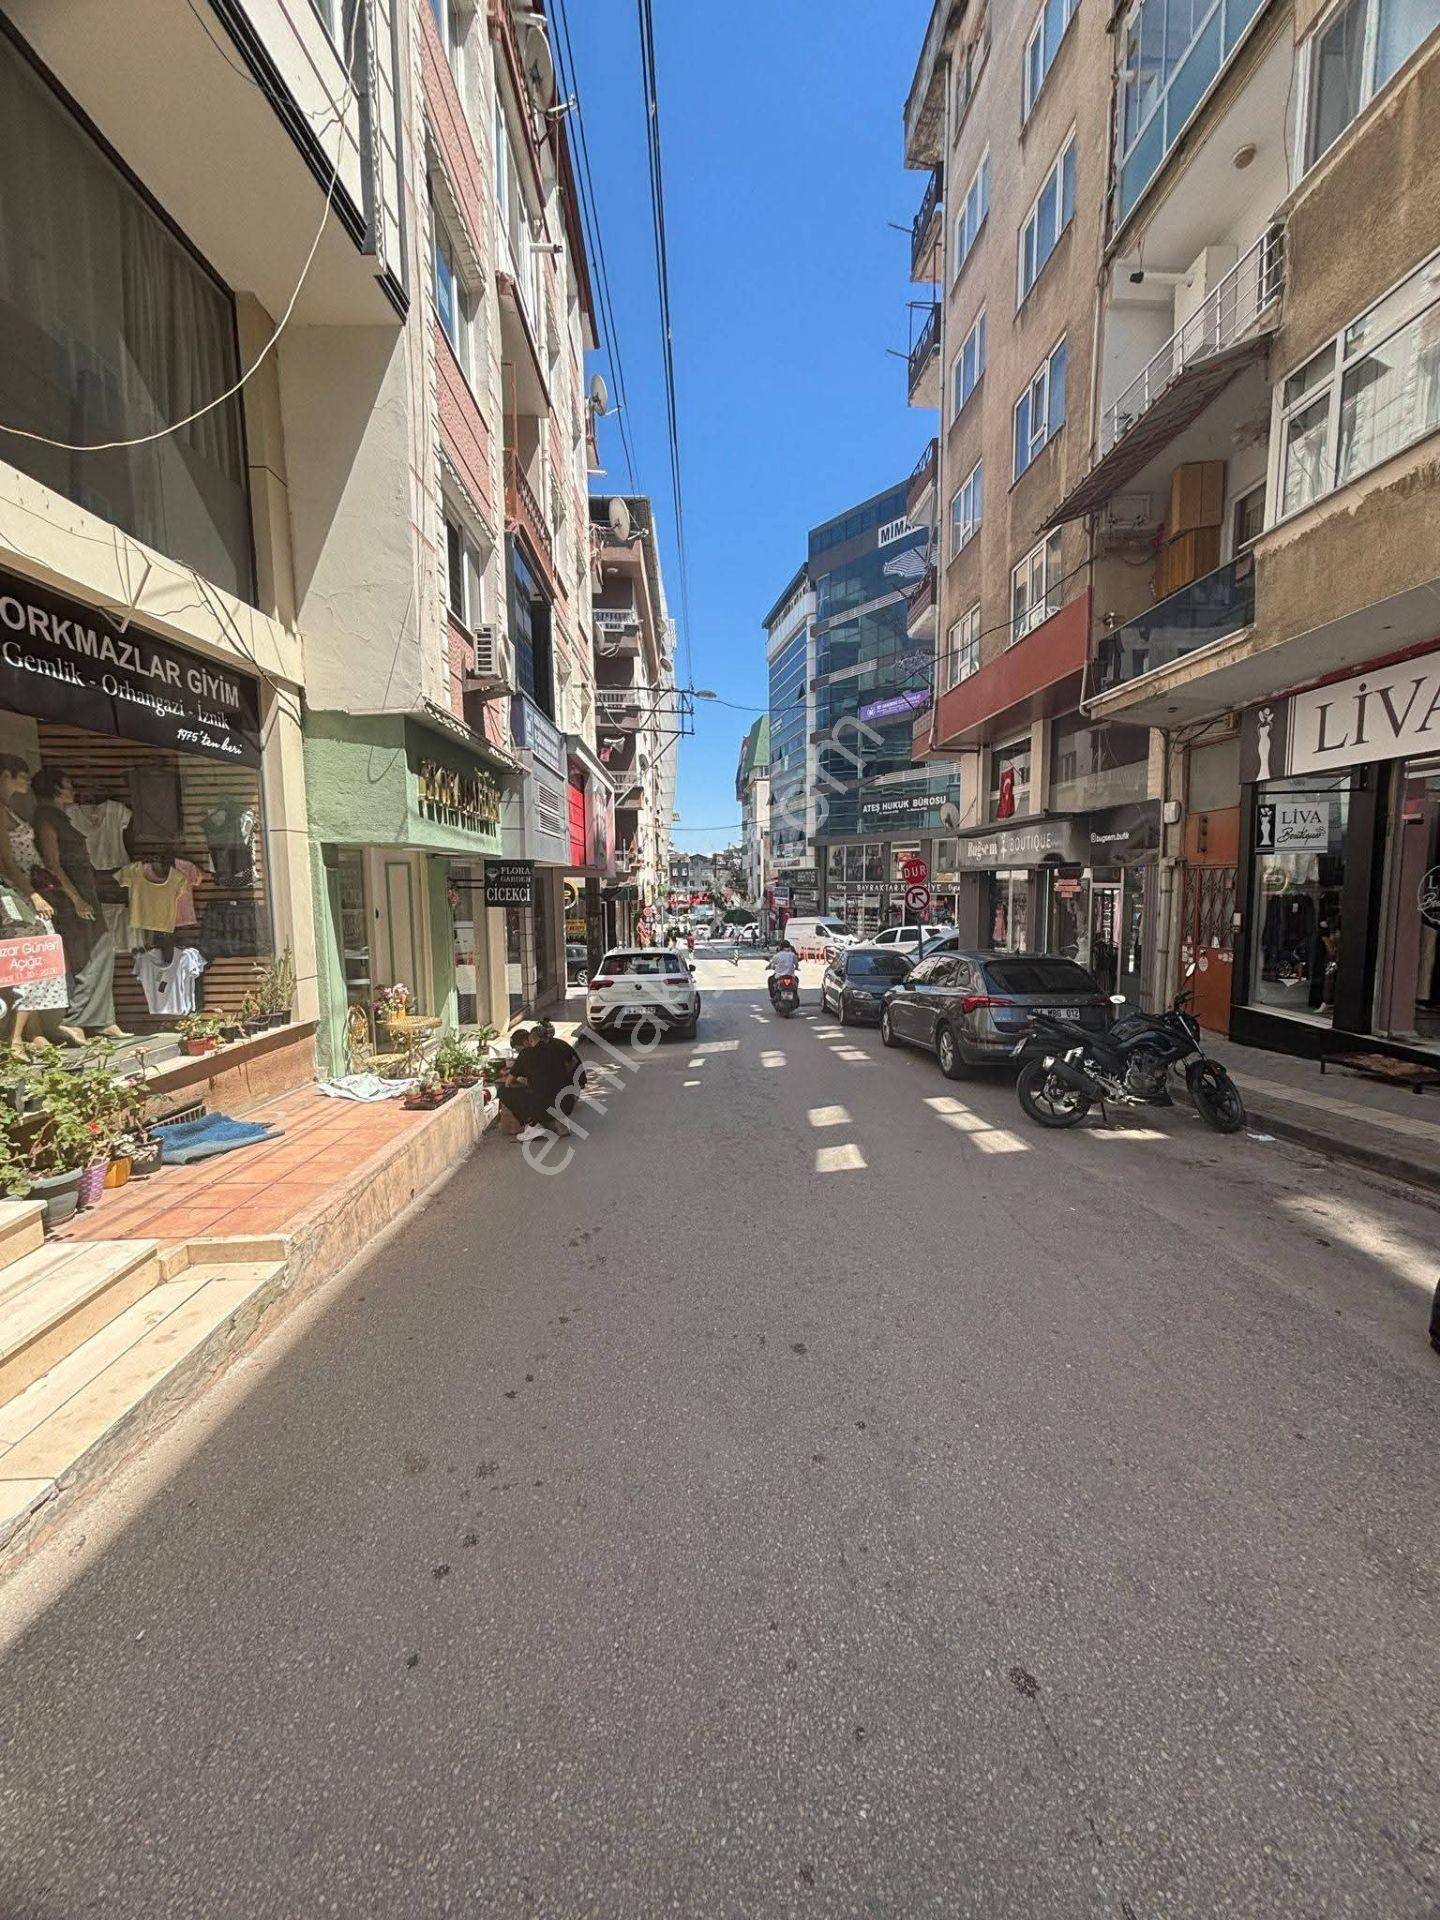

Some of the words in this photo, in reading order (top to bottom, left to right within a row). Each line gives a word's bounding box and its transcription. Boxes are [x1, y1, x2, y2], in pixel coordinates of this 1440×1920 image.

[0, 596, 182, 688] ORKMAZLAR
[187, 668, 239, 708] GİYİM
[2, 641, 86, 687] Gemlik
[102, 674, 185, 717] Orhangazi
[197, 700, 230, 730] İznik
[177, 728, 219, 749] 1975'ten
[220, 736, 242, 755] beri
[862, 803, 881, 814] ATEŞ
[882, 800, 909, 811] HUKUK
[912, 795, 947, 808] BÜROSU
[1281, 808, 1322, 825] LİVA
[903, 865, 927, 878] DUR
